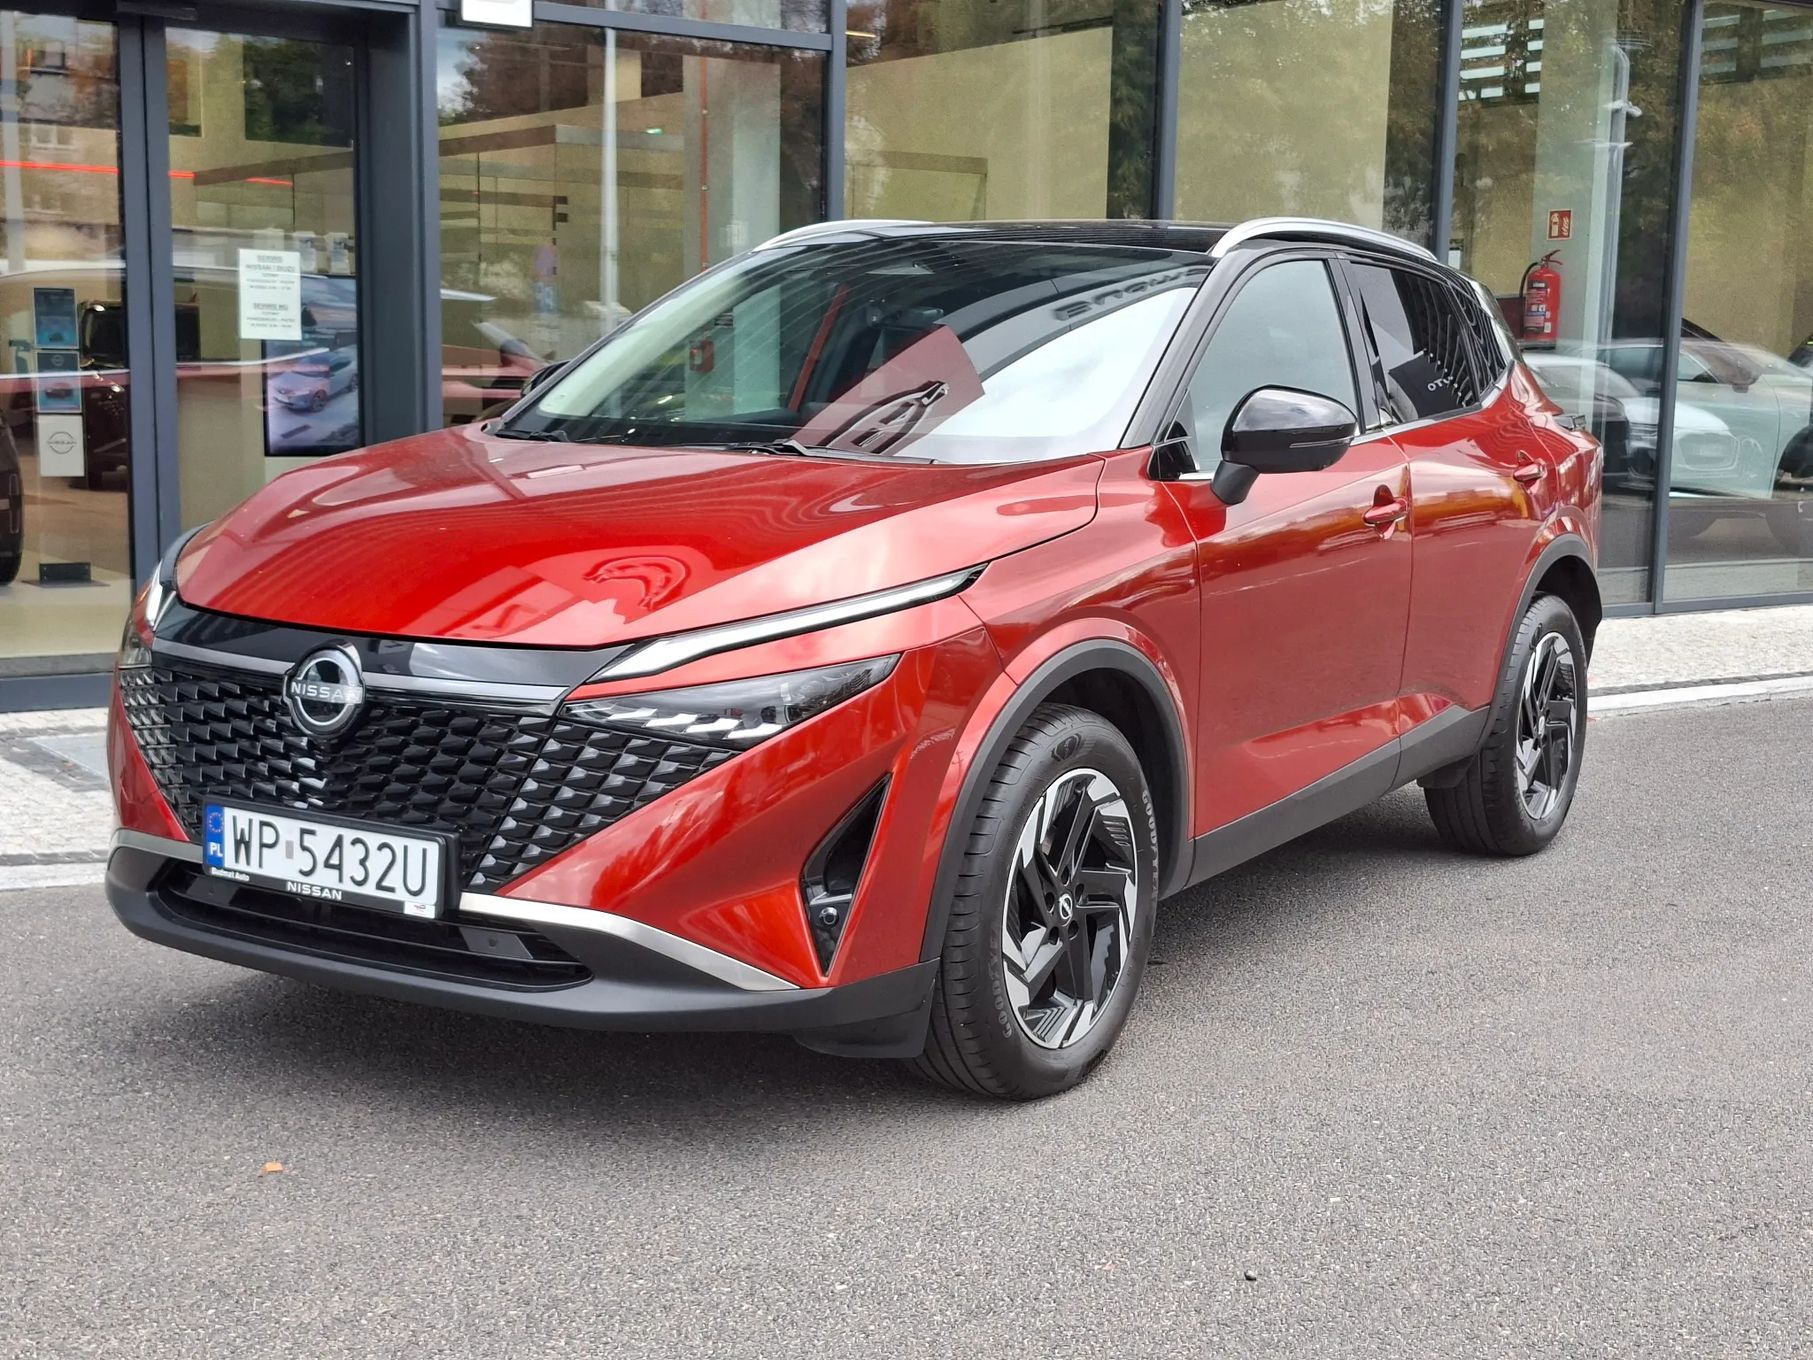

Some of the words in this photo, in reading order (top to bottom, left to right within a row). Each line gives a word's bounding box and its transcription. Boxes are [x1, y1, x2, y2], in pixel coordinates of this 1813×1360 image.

[209, 841, 223, 858] PL
[232, 815, 280, 869] WP
[299, 827, 427, 897] 5432U
[1142, 789, 1158, 905] GOODYEA
[286, 881, 342, 901] NISSAN
